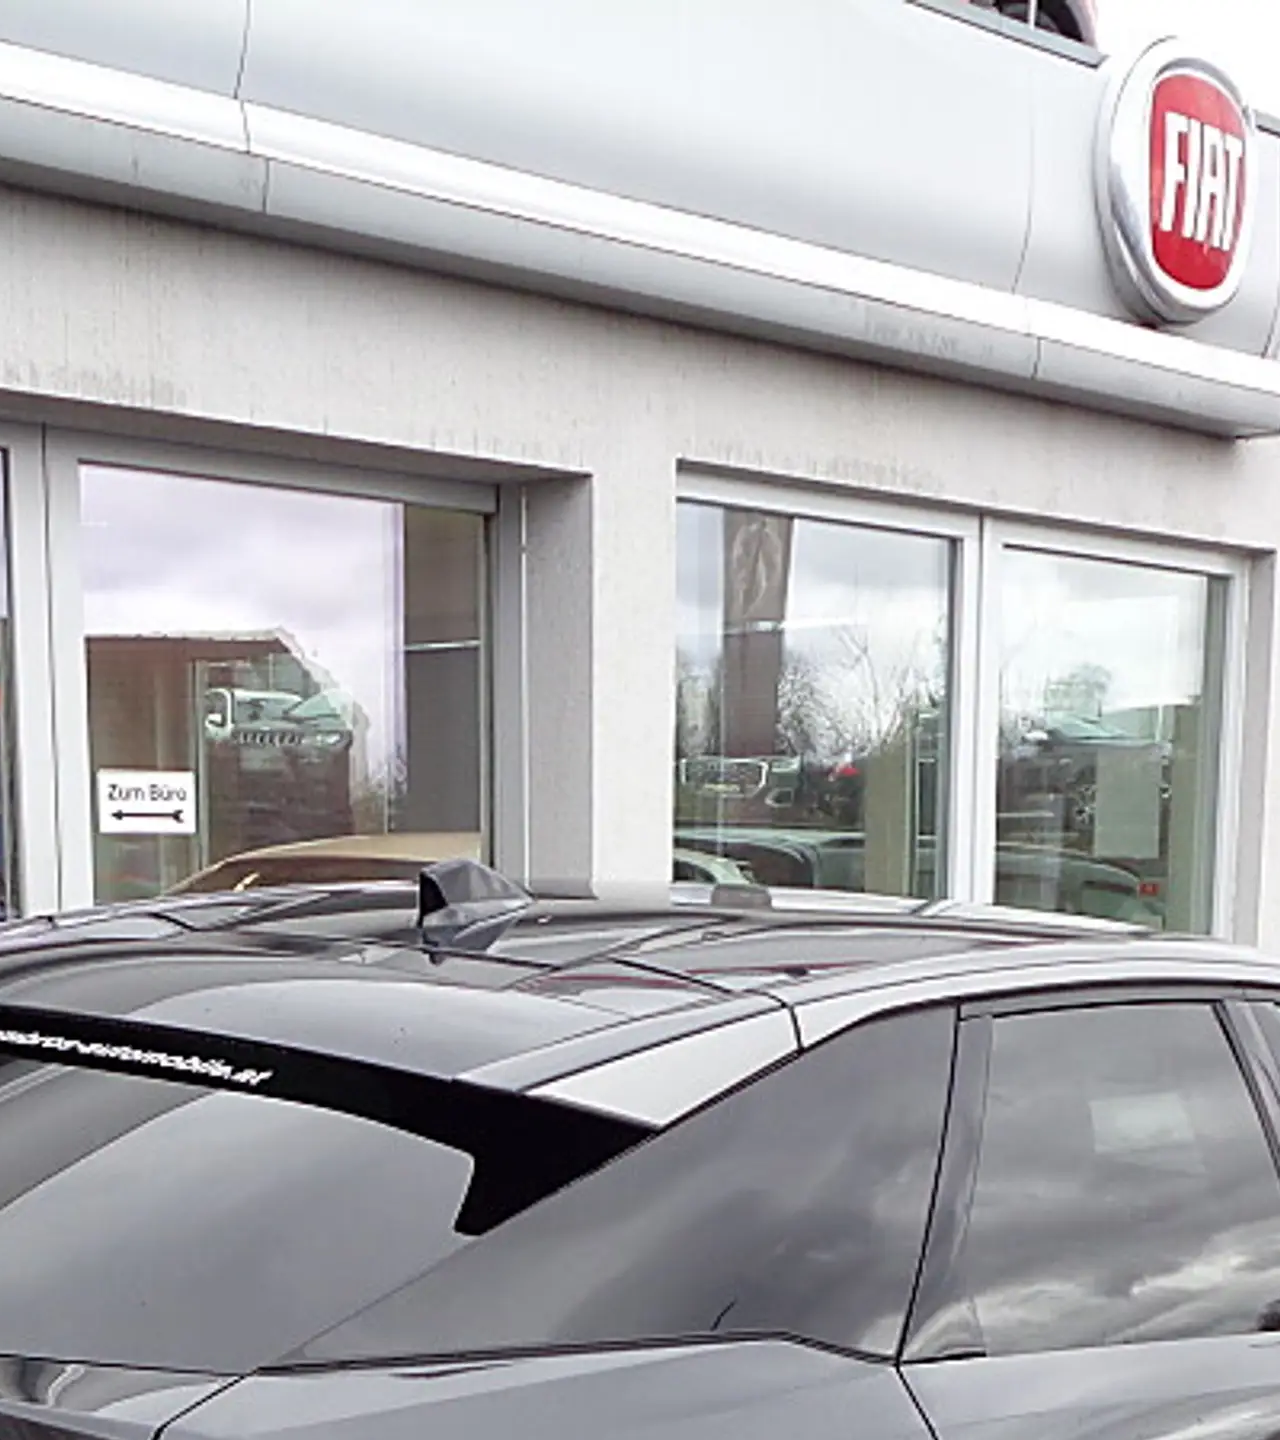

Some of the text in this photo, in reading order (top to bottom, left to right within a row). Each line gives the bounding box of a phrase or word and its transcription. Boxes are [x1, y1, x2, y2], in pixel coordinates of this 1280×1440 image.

[1160, 112, 1243, 251] FIAT
[107, 782, 187, 801] Zum Büro
